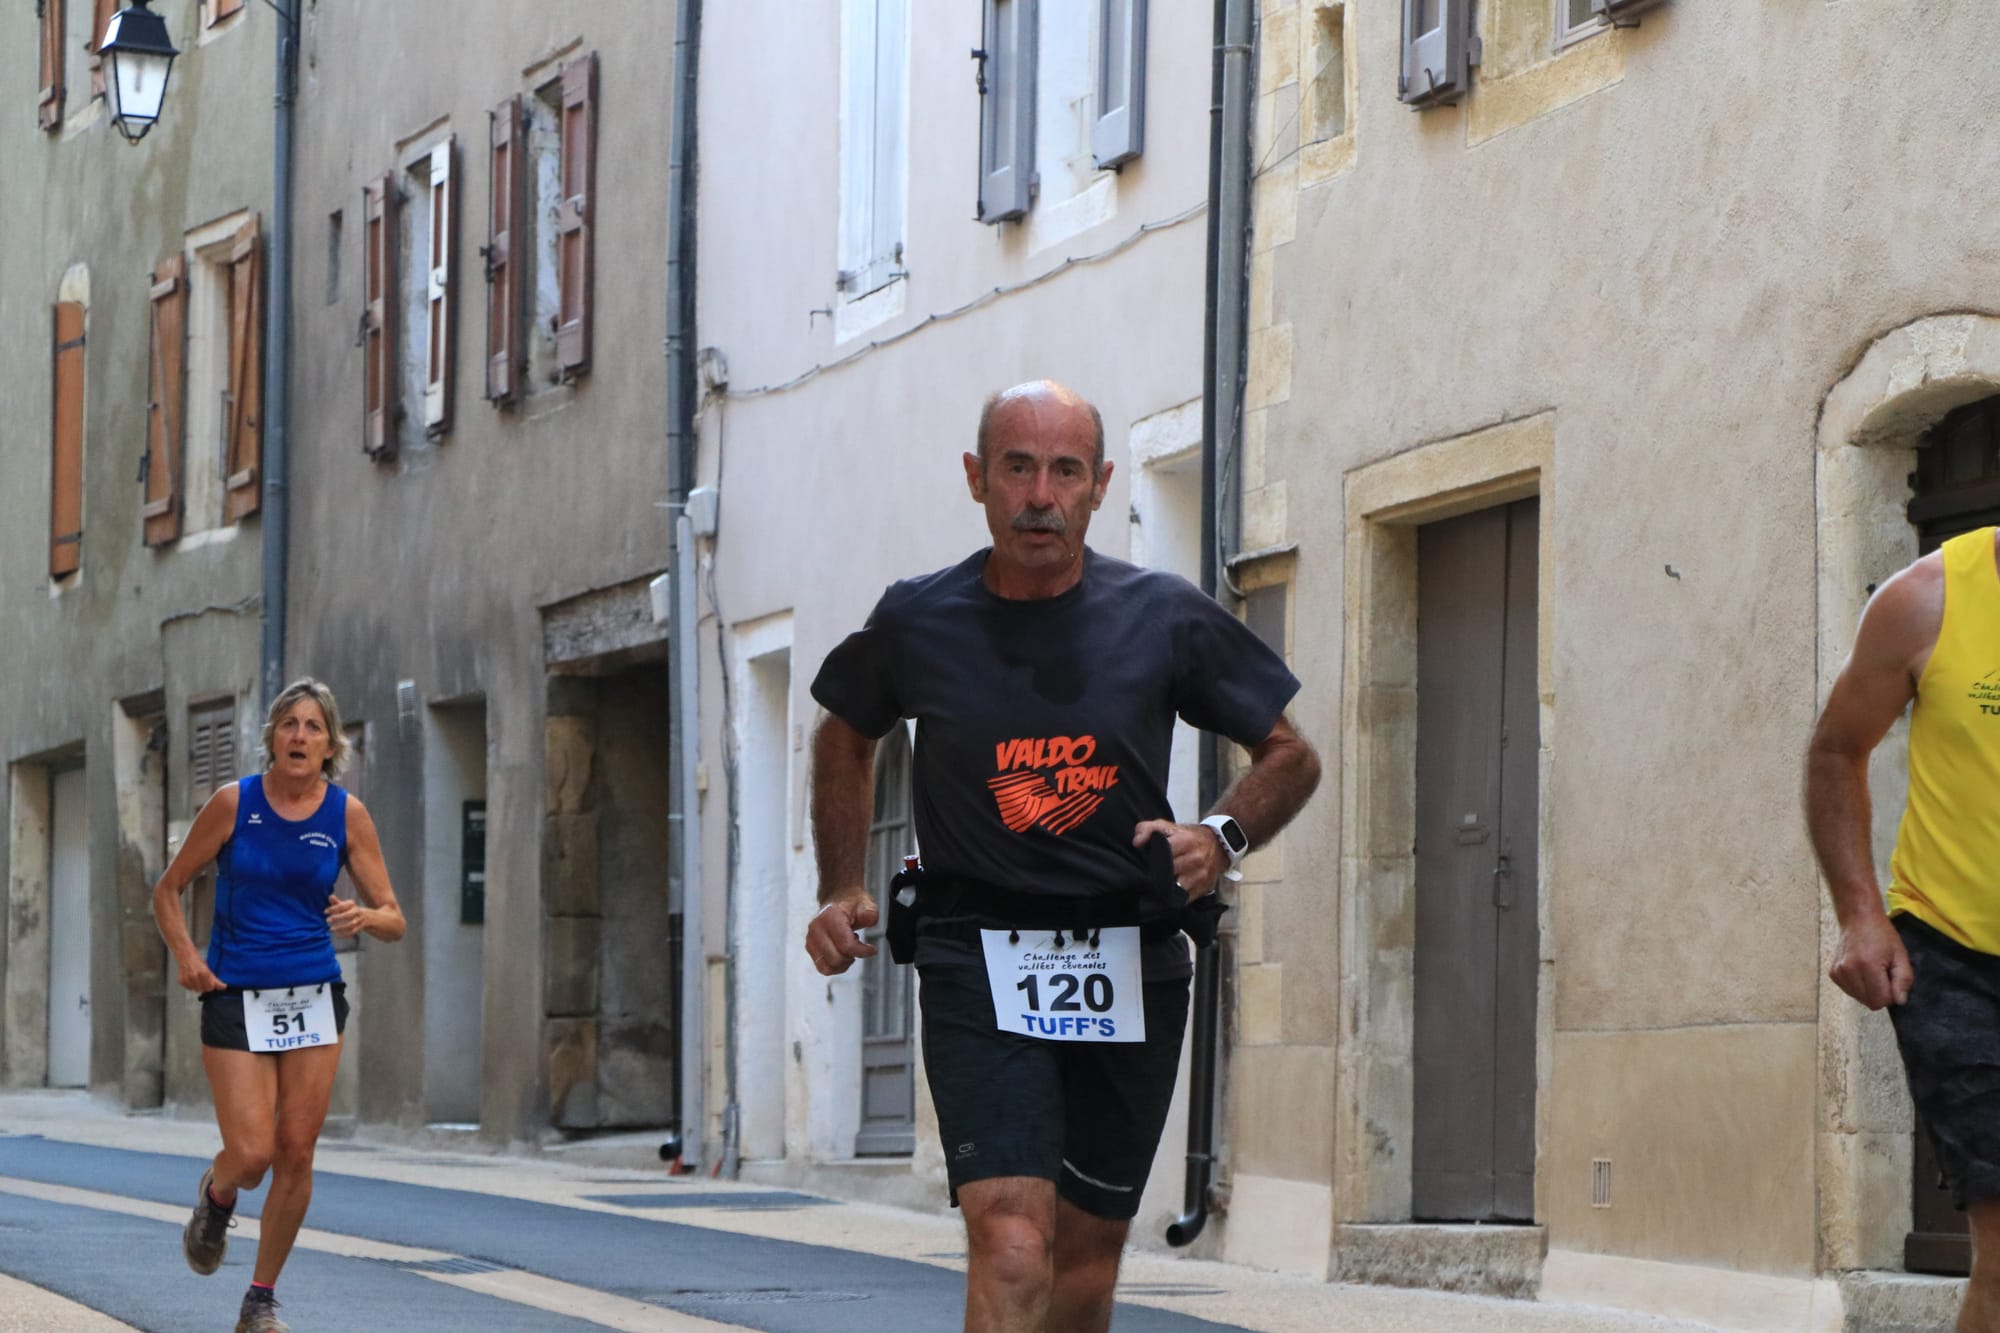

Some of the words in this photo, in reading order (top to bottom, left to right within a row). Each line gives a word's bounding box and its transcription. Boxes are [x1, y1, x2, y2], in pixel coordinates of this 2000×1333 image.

[996, 735, 1096, 772] VALDO
[1055, 765, 1120, 793] TRAIL
[1018, 962, 1055, 970] vallées
[1061, 962, 1107, 970] cévenoles
[1023, 953, 1077, 963] Challenge
[1083, 952, 1101, 960] des
[1016, 973, 1114, 1013] 120
[272, 1012, 306, 1035] 51
[1021, 1014, 1116, 1037] TUFF'S
[264, 1032, 321, 1049] TUFF'S
